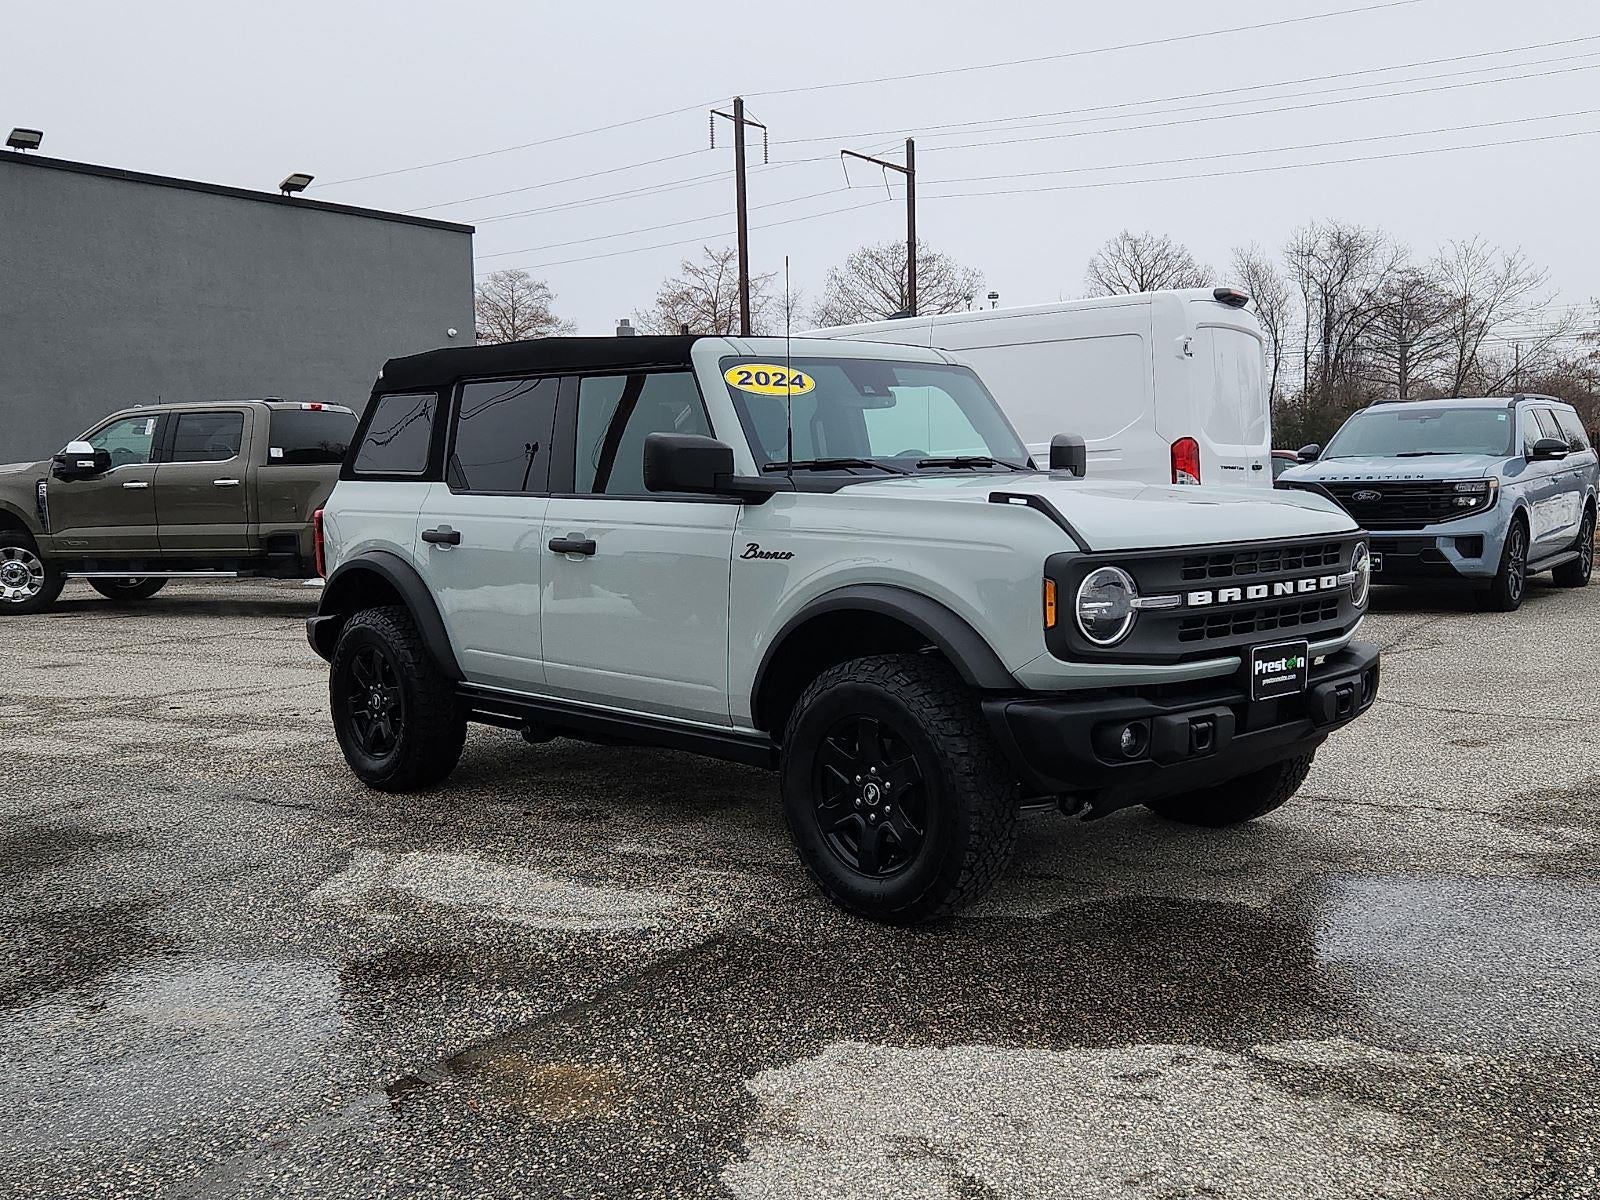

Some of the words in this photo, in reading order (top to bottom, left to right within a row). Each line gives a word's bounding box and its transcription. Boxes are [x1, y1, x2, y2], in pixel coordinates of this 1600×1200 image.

[736, 370, 806, 389] 2024
[740, 542, 795, 560] Bronco
[1187, 575, 1337, 606] BRONCO
